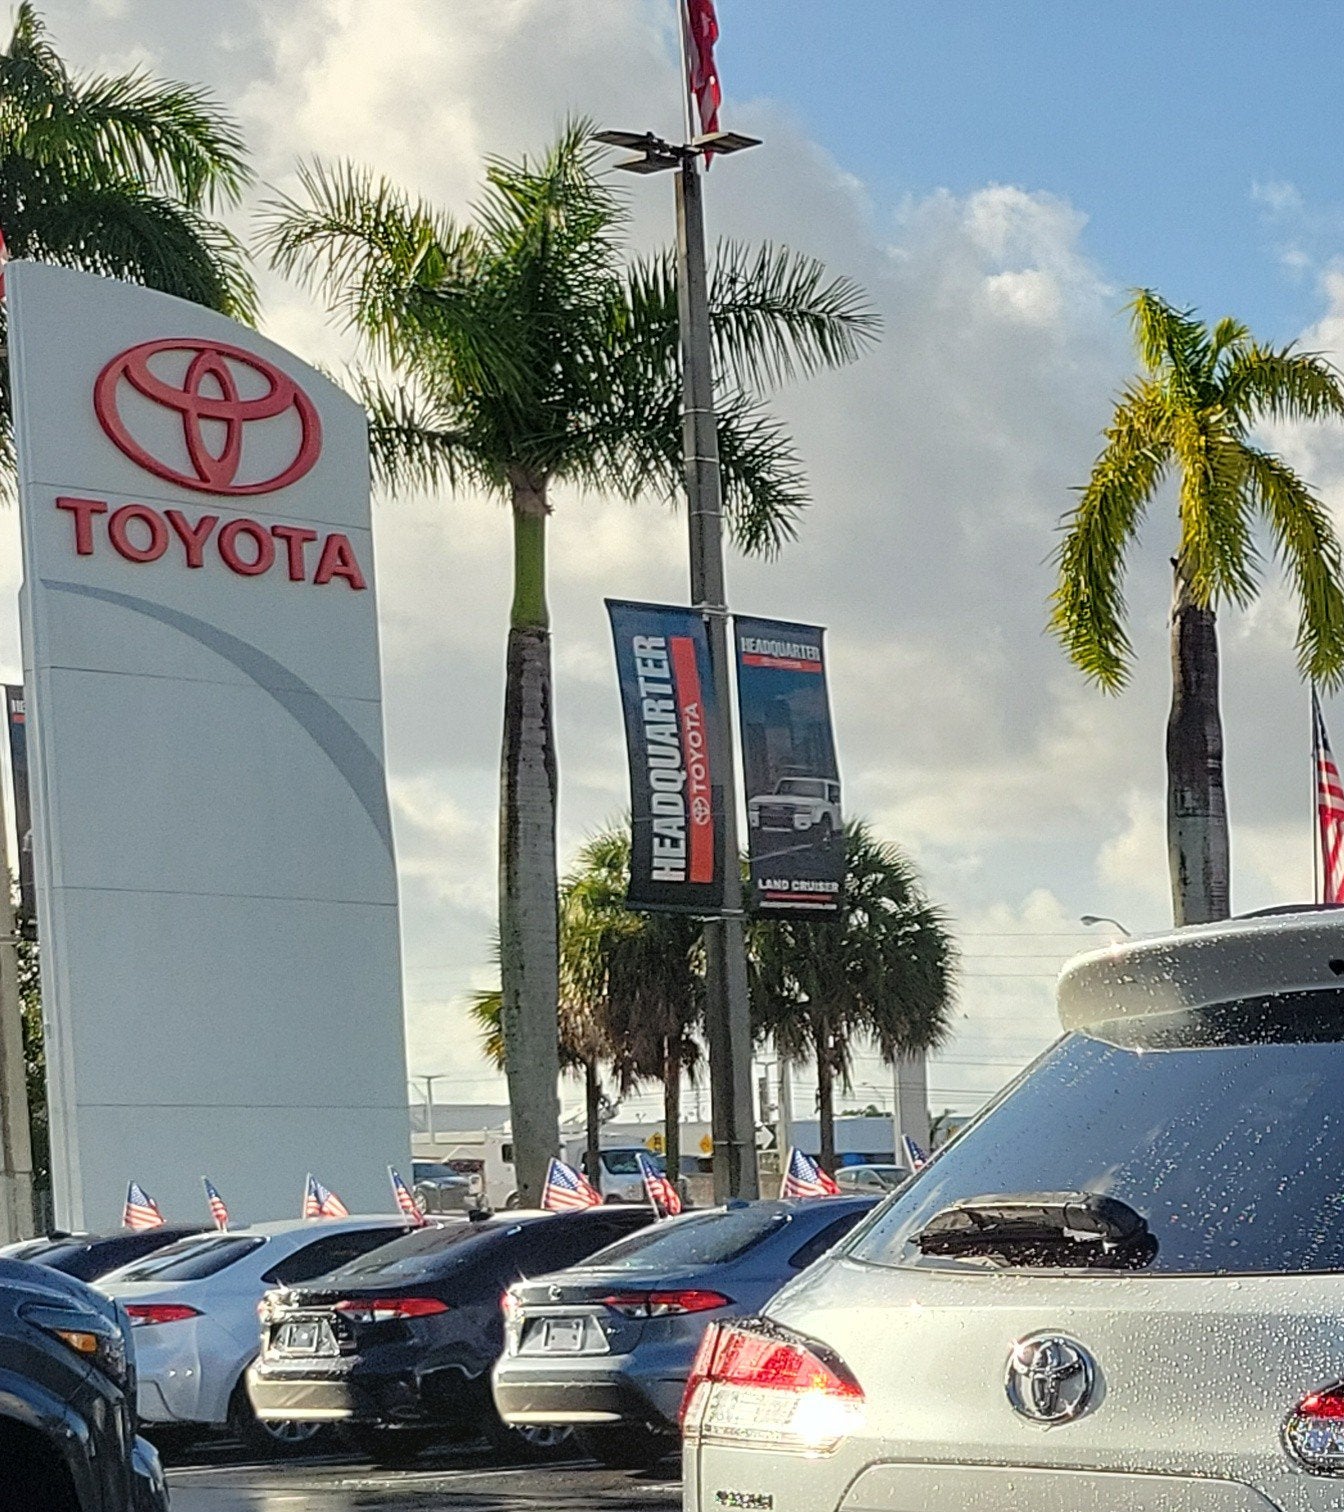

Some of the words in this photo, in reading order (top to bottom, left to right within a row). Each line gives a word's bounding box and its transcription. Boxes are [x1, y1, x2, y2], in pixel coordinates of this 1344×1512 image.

[55, 496, 368, 591] TOYOTA
[741, 636, 821, 662] HEADQUARTER
[633, 634, 687, 882] HEADQUARTER
[684, 702, 707, 794] TOYOTA
[758, 878, 790, 891] LAND
[791, 880, 840, 893] CRUISER
